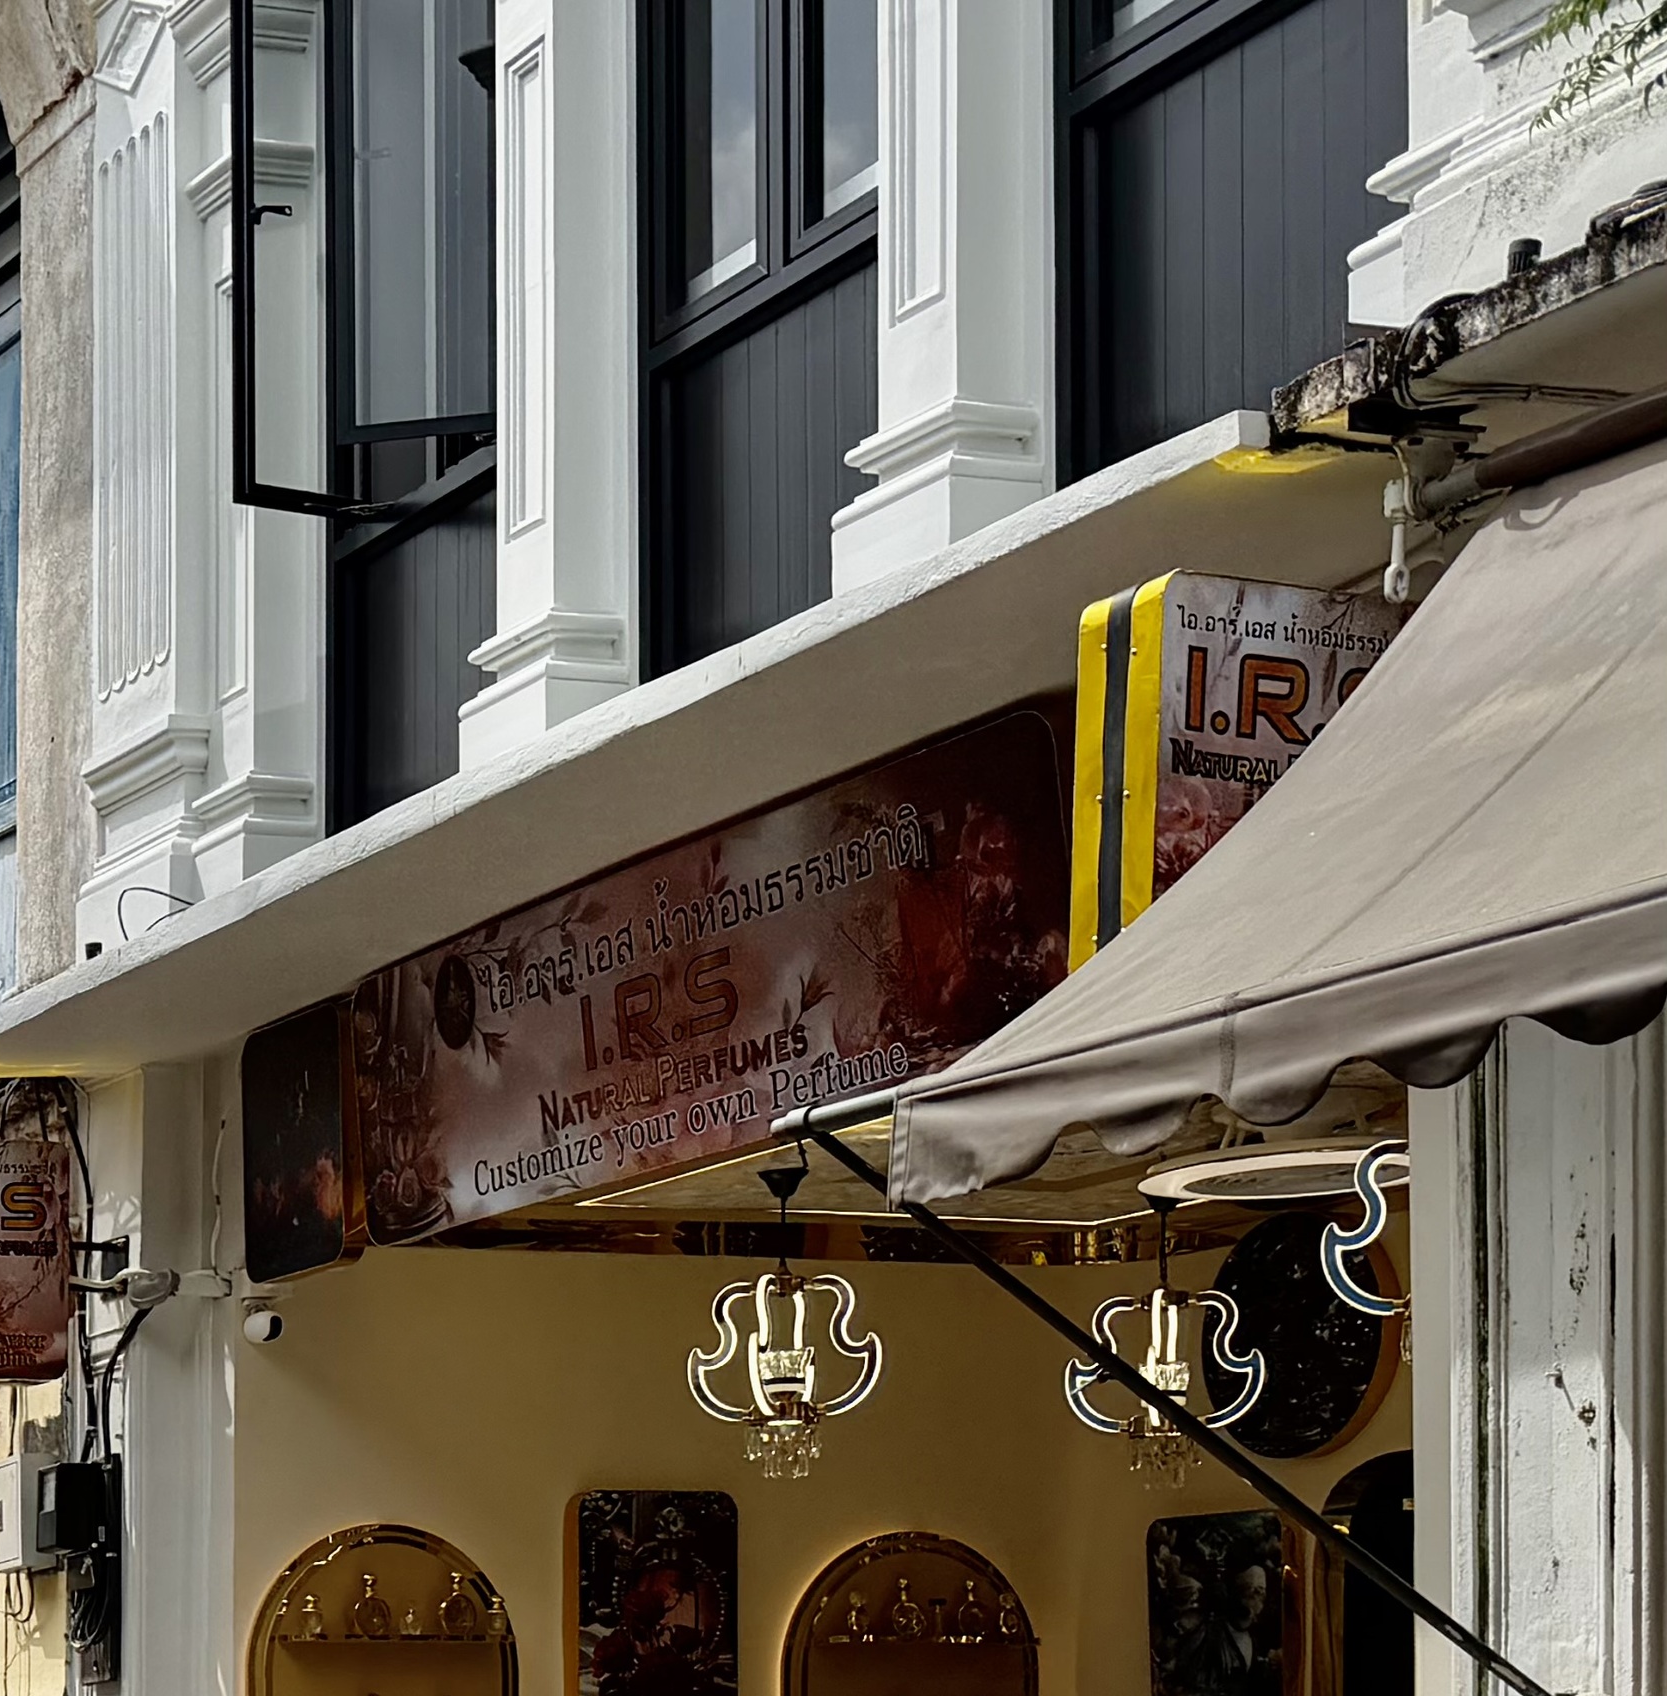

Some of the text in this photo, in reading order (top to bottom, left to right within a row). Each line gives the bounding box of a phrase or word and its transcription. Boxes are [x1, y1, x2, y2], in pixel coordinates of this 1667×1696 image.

[1185, 645, 1369, 746] I.R.
[579, 945, 739, 1072] I.R.S
[473, 1040, 910, 1197] Customize your own Perfume
[537, 1022, 808, 1136] NATURAL PERFUMES
